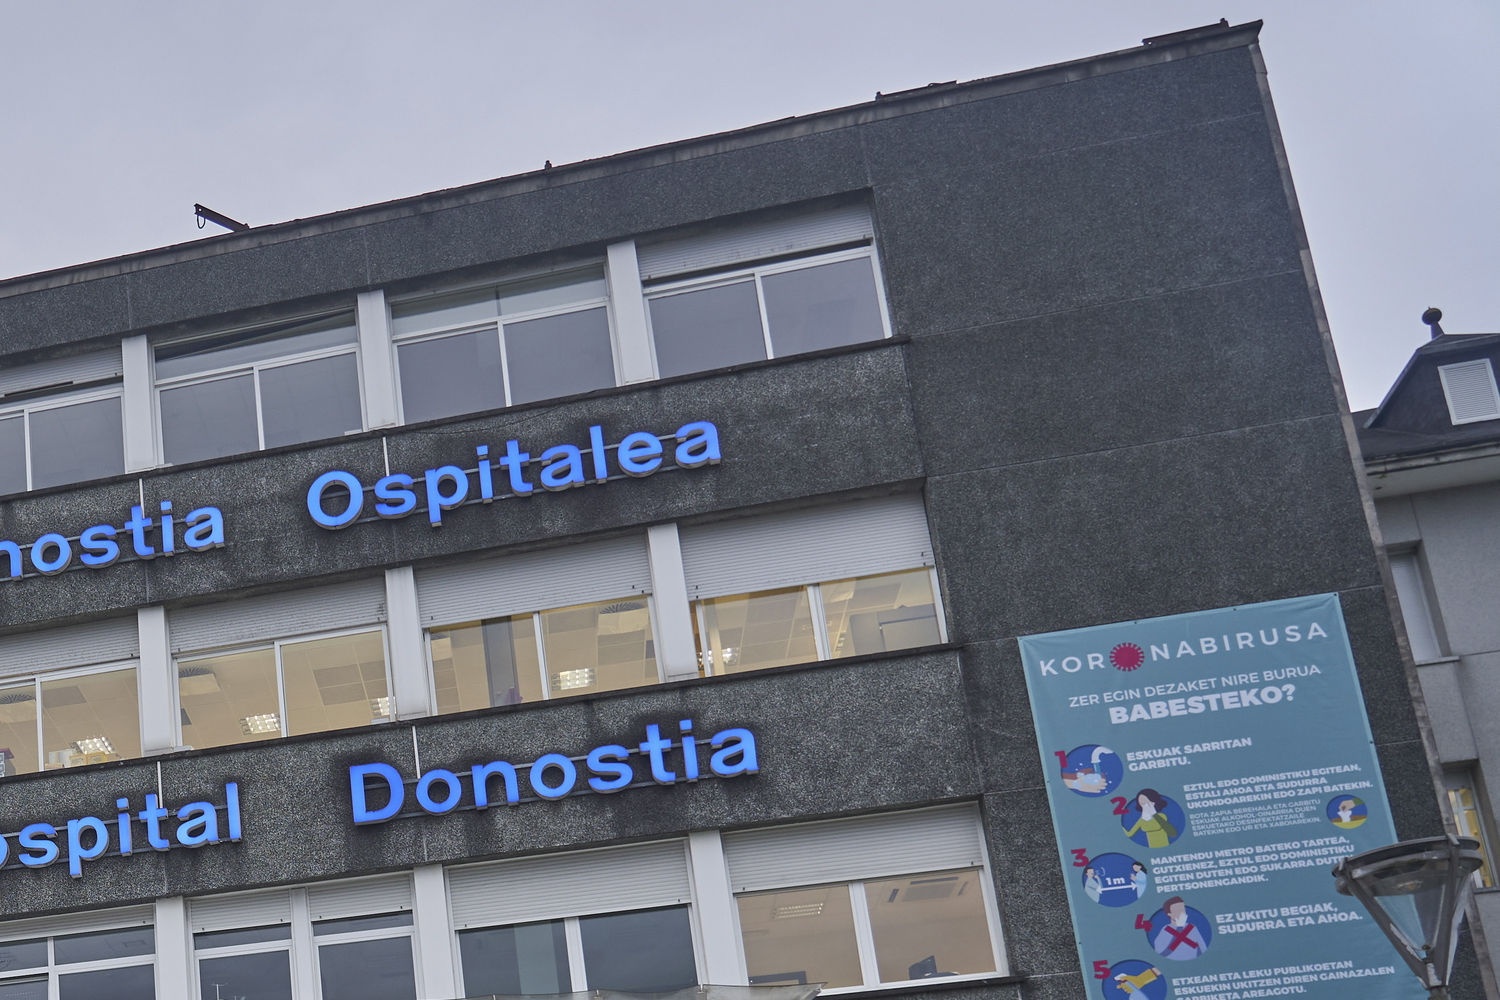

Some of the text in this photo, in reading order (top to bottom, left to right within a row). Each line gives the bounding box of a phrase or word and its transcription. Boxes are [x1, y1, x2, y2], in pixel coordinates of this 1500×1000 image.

[306, 420, 721, 531] Ospitalea
[1068, 664, 1321, 708] ZER EGIN DEZAKET NIRE BURUA
[1109, 684, 1296, 724] BABESTEKO?
[1054, 750, 1068, 768] 1
[1126, 737, 1252, 762] ESKUAK SARRITAN
[349, 719, 760, 826] Donostia
[1128, 757, 1191, 771] GARBITU.
[1183, 764, 1361, 792] EZTUL EDO DOMINISTIKU EGITEAN,
[1185, 777, 1327, 801] ESTALI AHOA ETA SUDURRA
[1110, 797, 1130, 816] 2
[1187, 781, 1373, 809] UKONDOAREKIN EDO ZAPI BATEKIN.
[1071, 848, 1090, 867] 3
[1151, 836, 1349, 865] MANTENDU METRO BATEKO TARTEA,
[1153, 845, 1354, 874] GUTXIENEZ, EZTUL EDO DOMINISTIKU
[1155, 854, 1352, 884] EGITEN DUTEN EDO SUKARRA DUT
[1157, 874, 1268, 893] PERTSONENGANDIK.
[1134, 913, 1153, 932] 4
[1215, 902, 1338, 924] EZ UKITU BEGIAK,
[1218, 911, 1363, 935] SUDURRA ETA AHOA.
[1093, 960, 1111, 980] 5
[1172, 960, 1353, 987] ETXEAN ETA LEKU PUBLIKOETAN
[1174, 966, 1395, 997] ESKUEKIN UKITZEN DIREN GAINAZALEN
[1242, 986, 1307, 1000] AREAGOTU.
